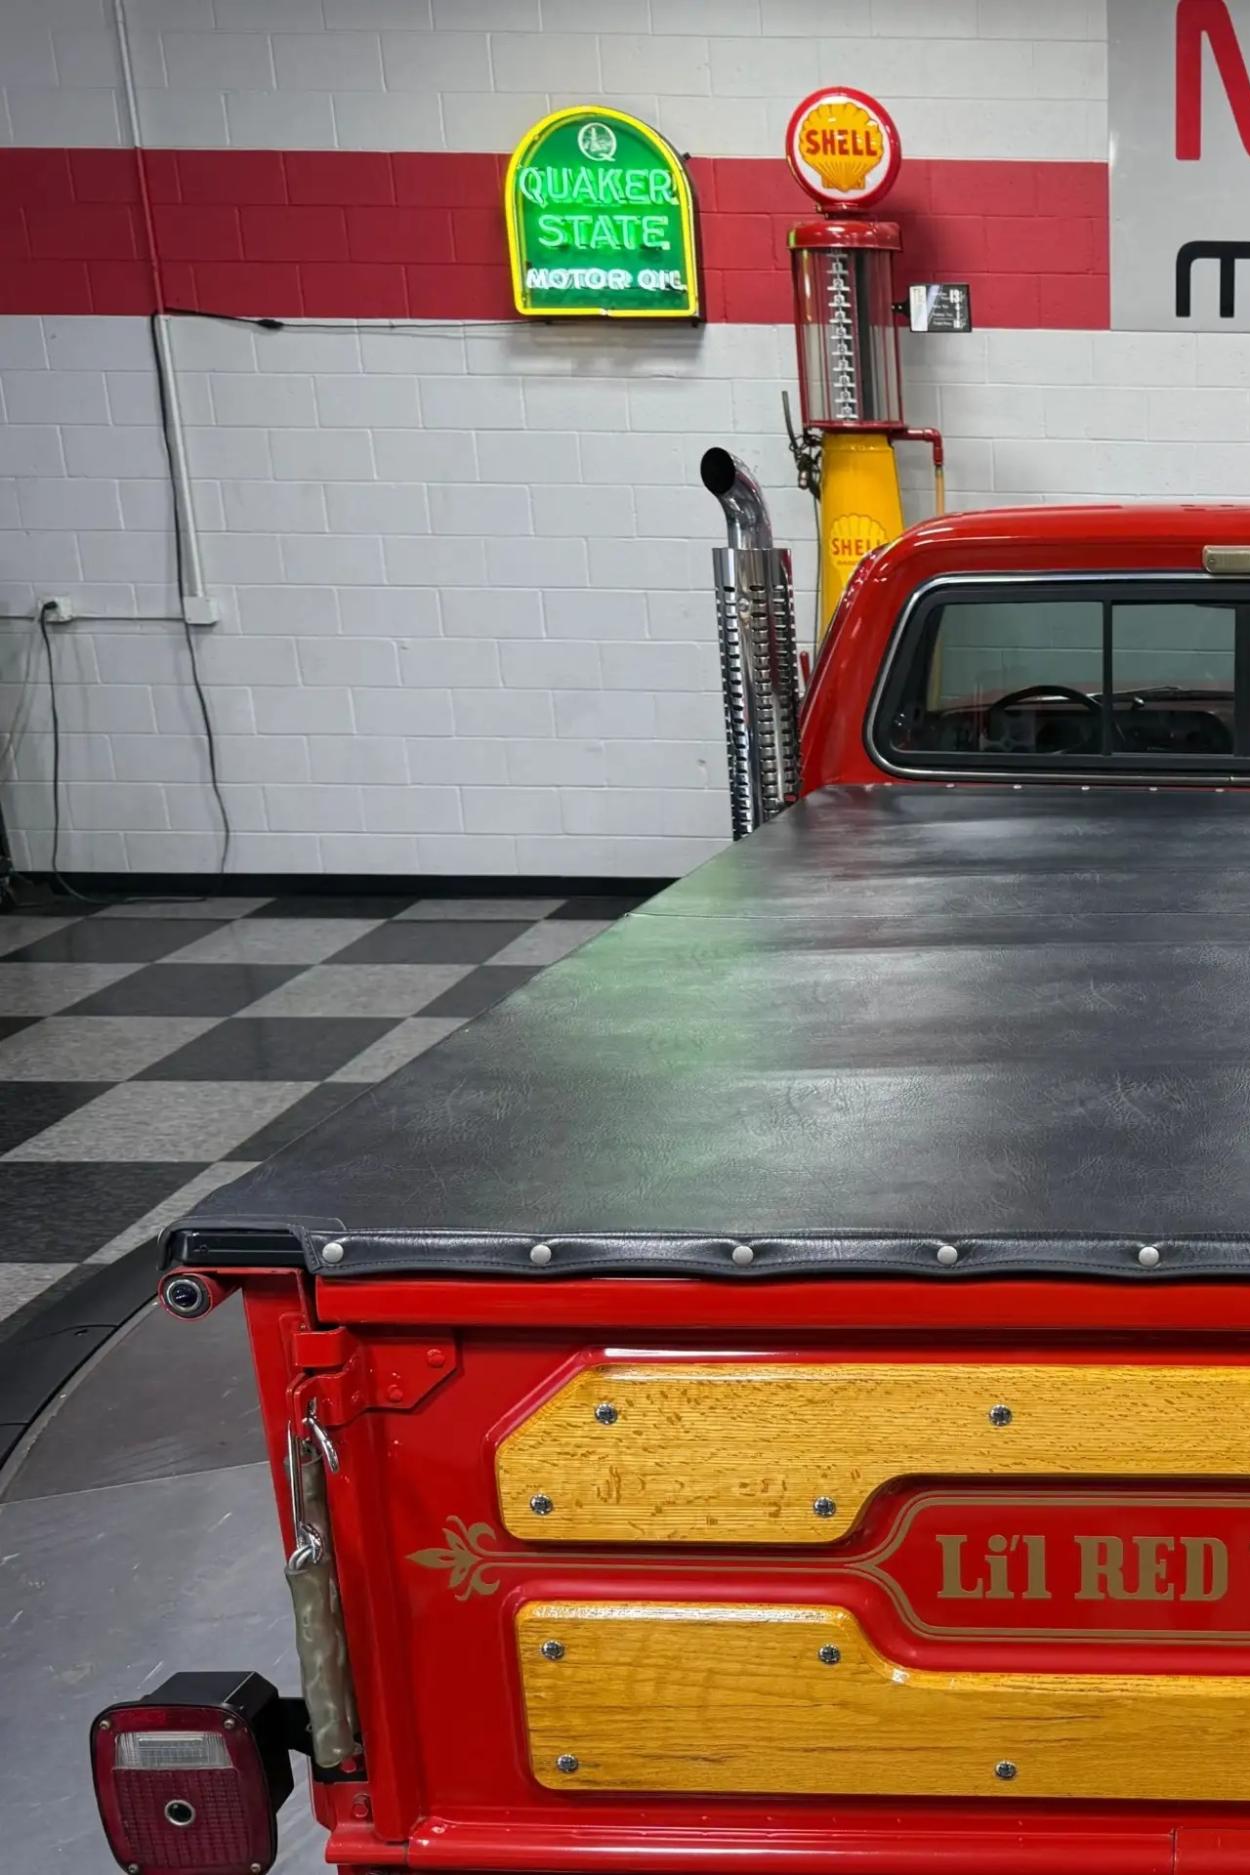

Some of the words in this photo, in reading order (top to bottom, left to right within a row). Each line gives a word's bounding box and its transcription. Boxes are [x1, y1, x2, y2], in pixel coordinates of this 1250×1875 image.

[805, 129, 877, 157] SHELL
[519, 166, 679, 208] QUAKER
[538, 214, 671, 250] STATE
[526, 268, 633, 290] MOTOR
[637, 269, 687, 291] OIL
[935, 1534, 1052, 1599] Li'l
[1074, 1535, 1230, 1602] RED
